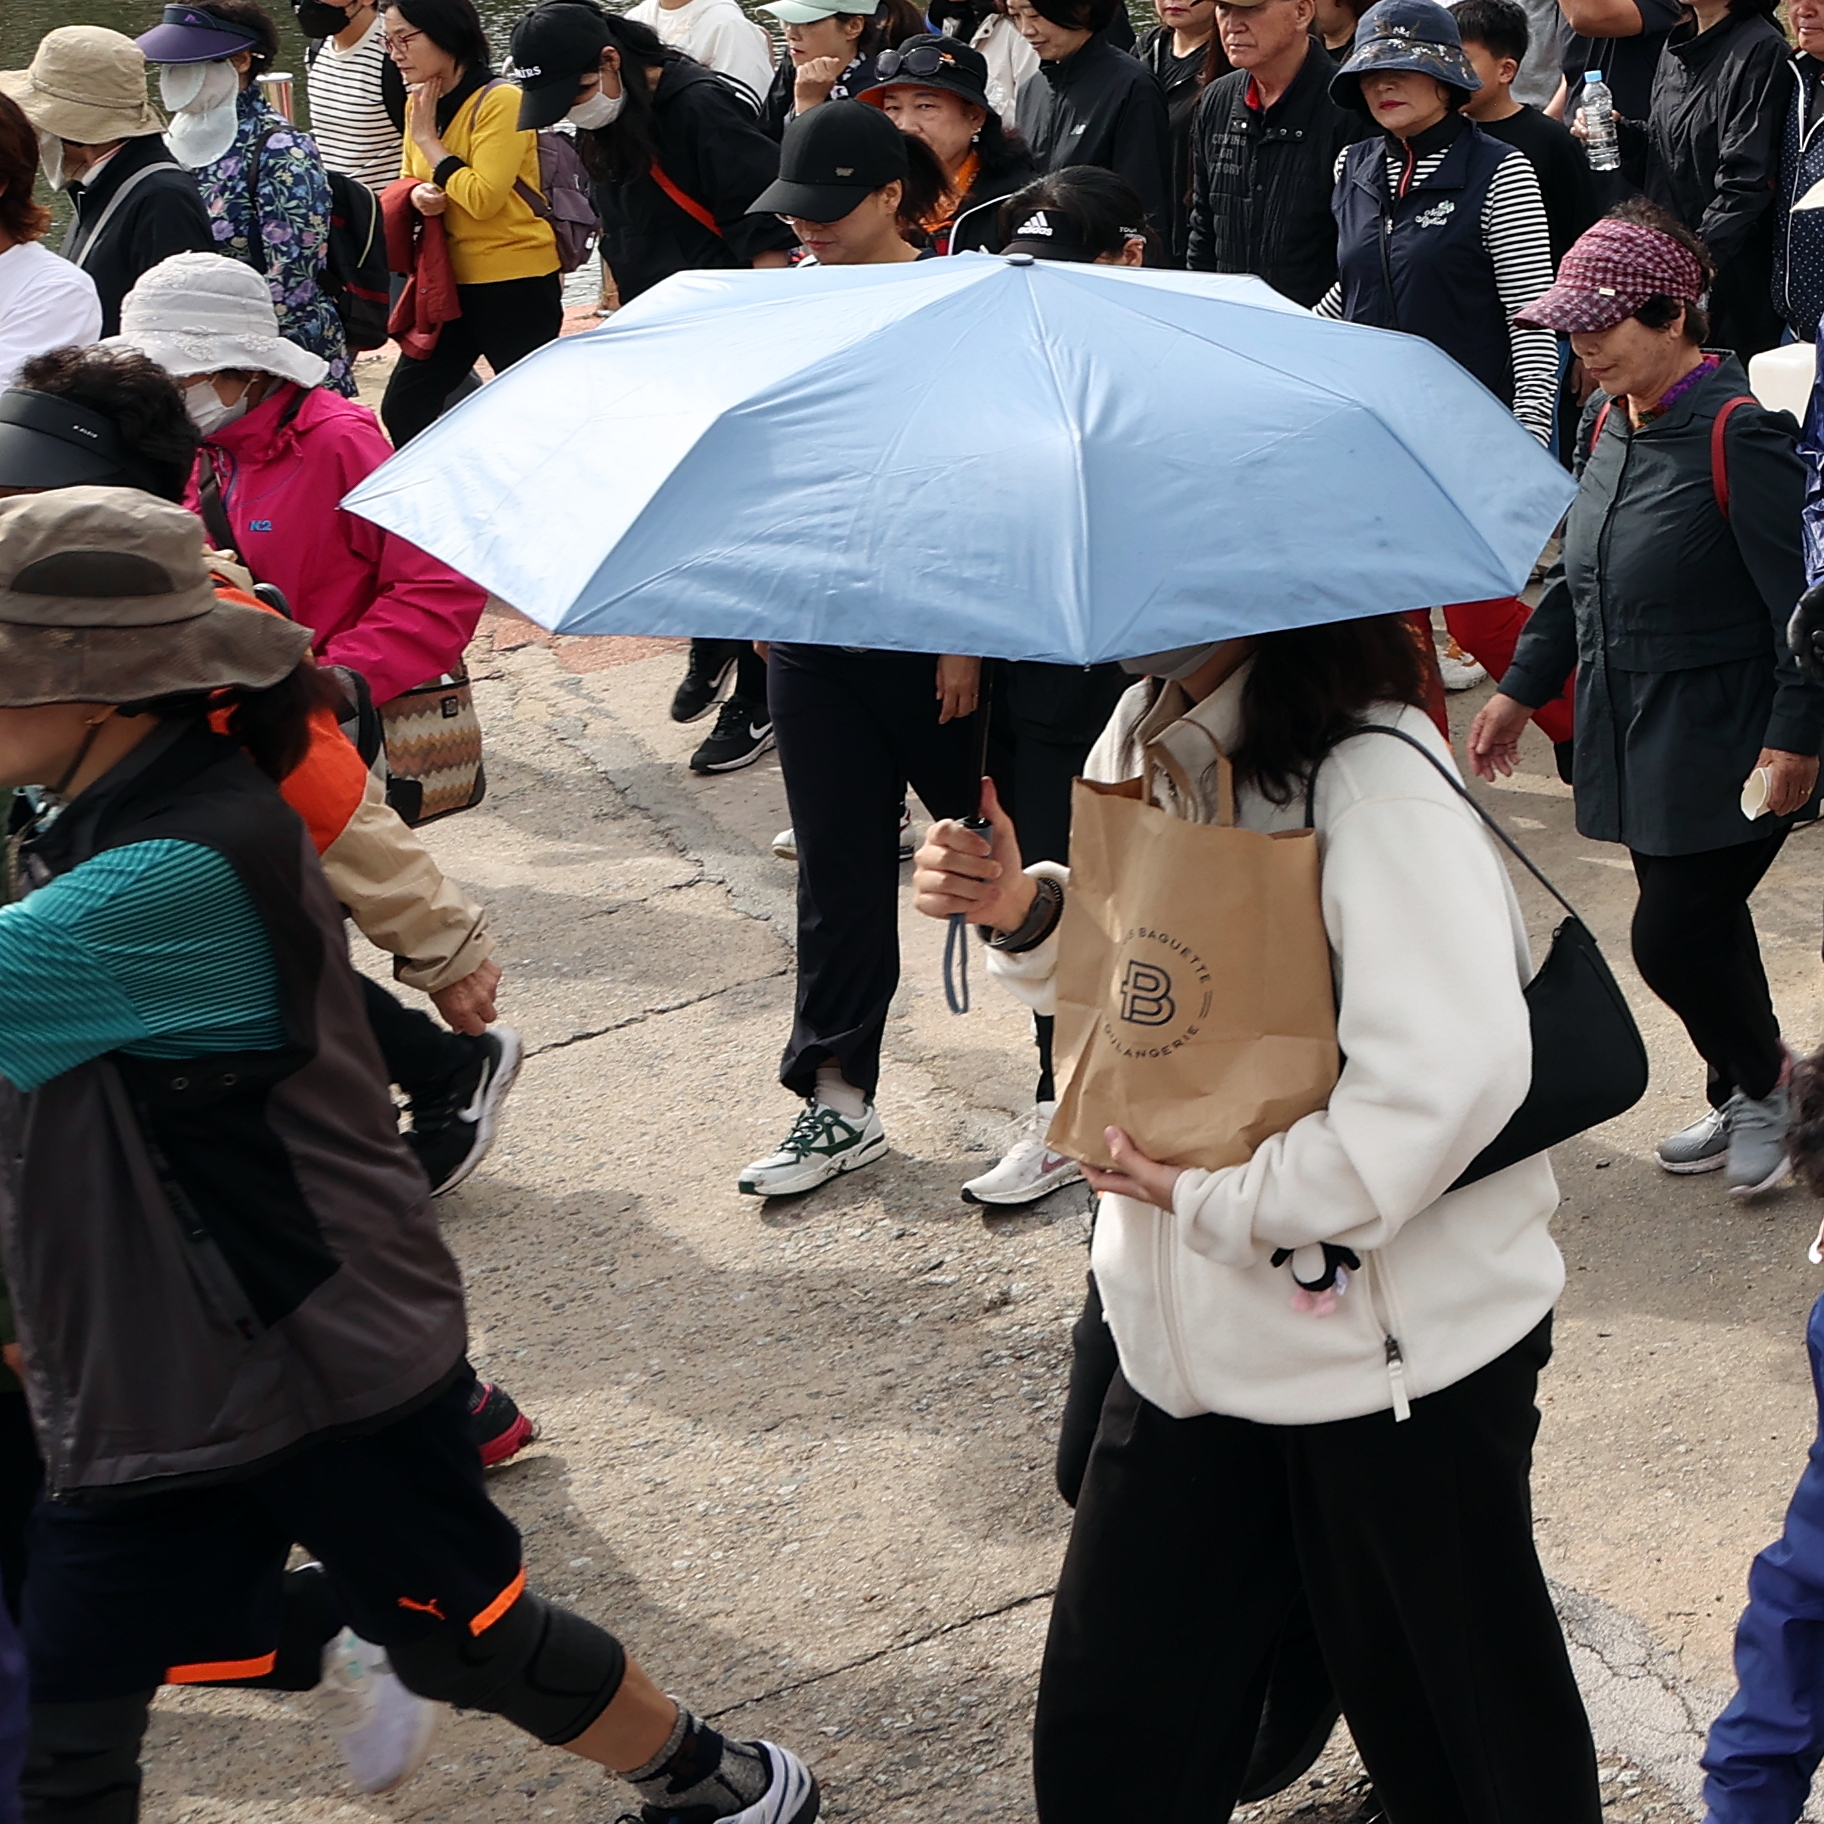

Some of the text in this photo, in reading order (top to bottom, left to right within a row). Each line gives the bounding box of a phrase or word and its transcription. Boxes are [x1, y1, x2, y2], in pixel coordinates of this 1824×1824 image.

[1017, 226, 1053, 236] adidas
[249, 520, 272, 531] K2
[1139, 927, 1212, 984] BAGUETTE
